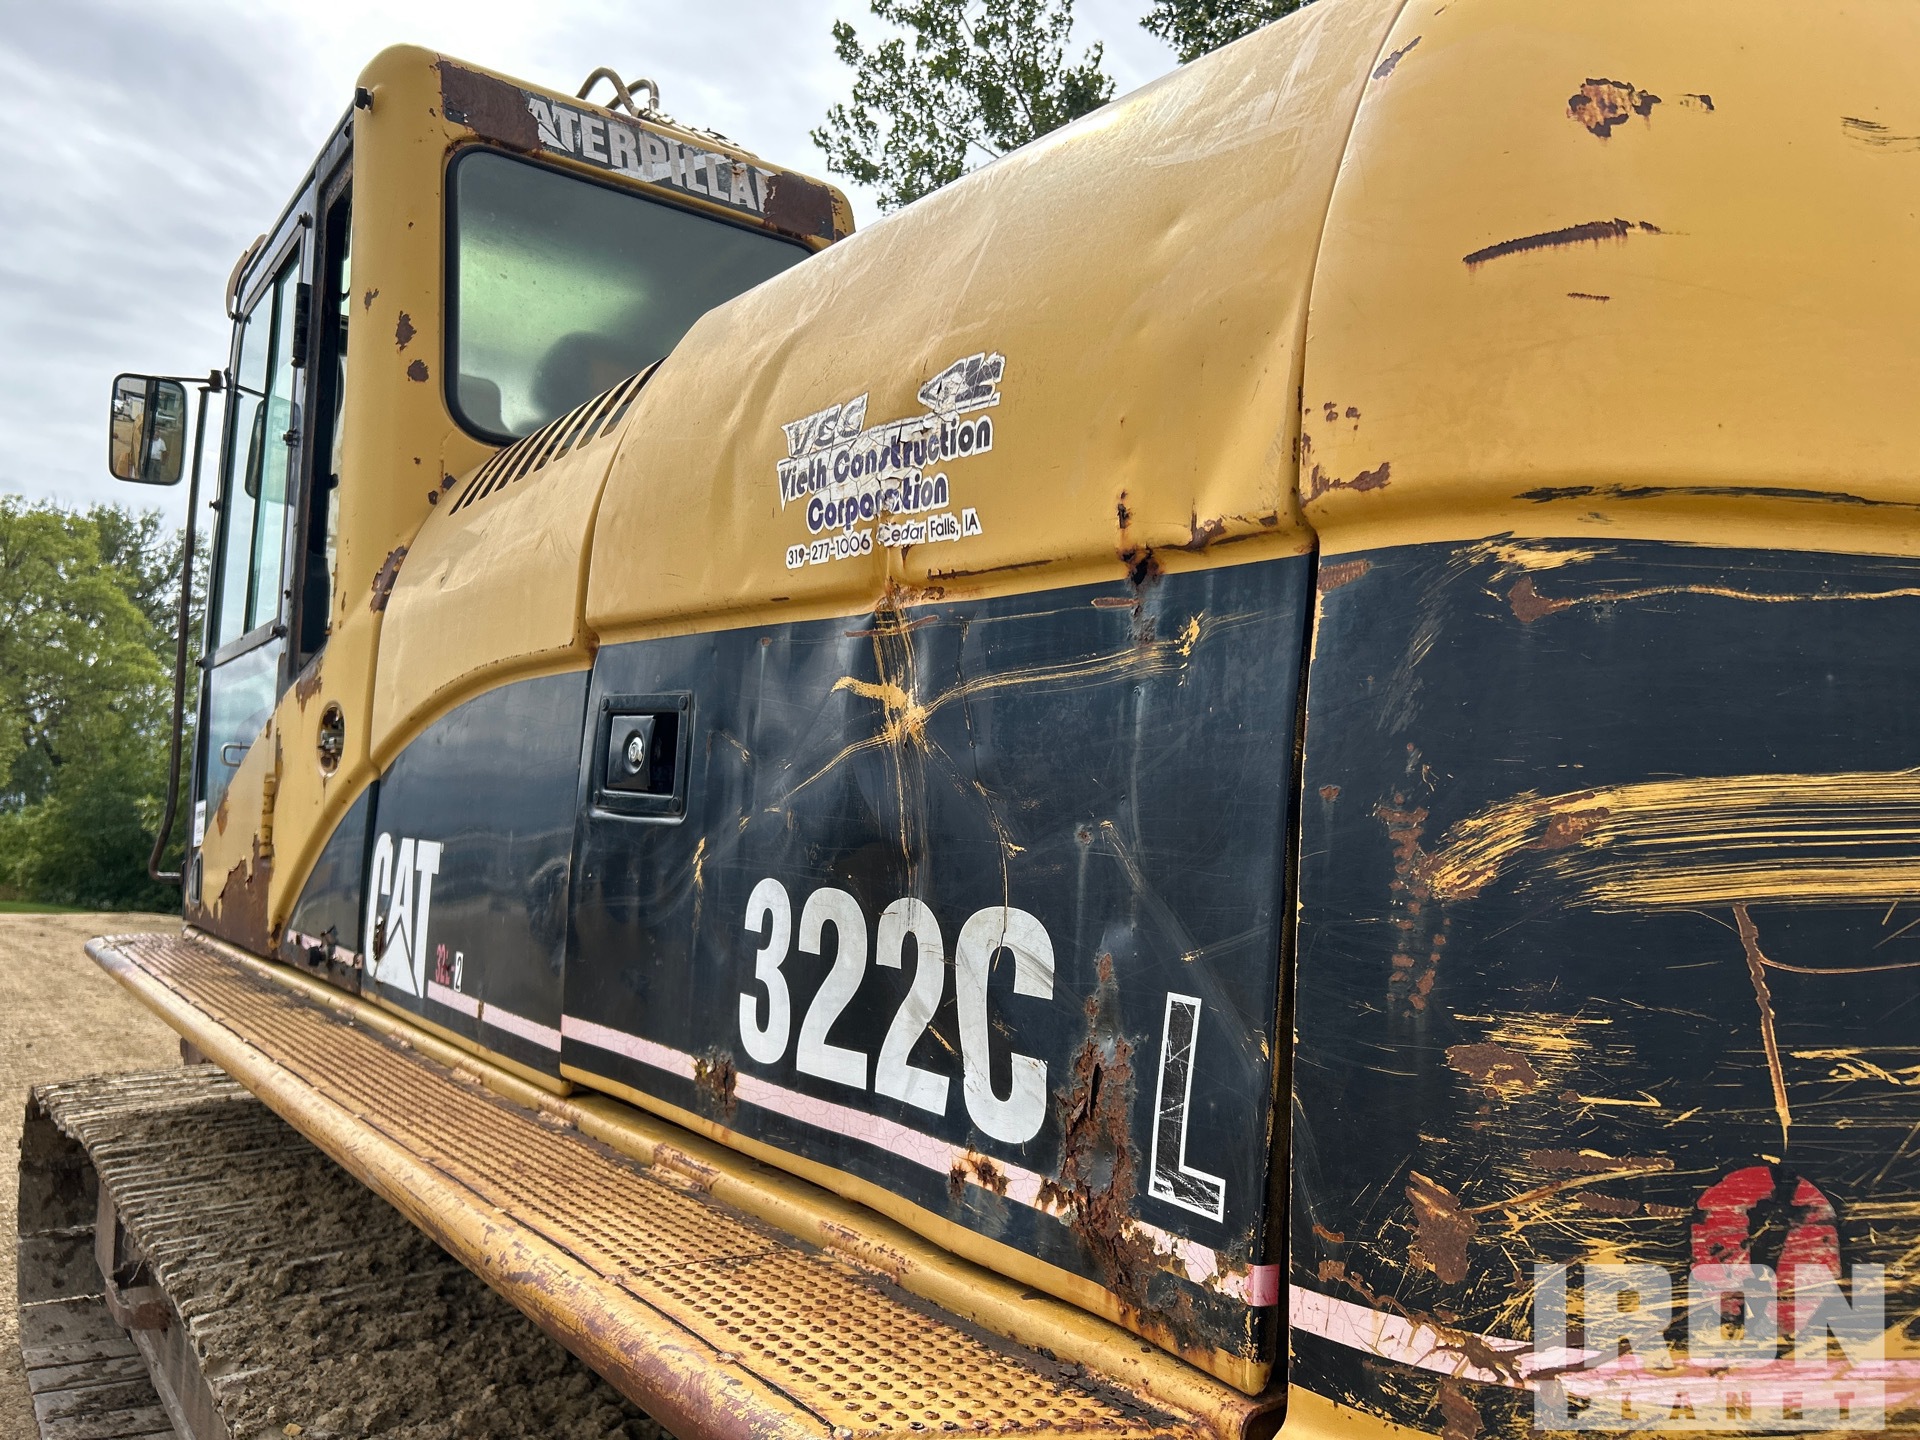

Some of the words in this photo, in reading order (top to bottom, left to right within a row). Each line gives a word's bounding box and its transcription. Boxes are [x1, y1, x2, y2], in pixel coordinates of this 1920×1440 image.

[780, 458, 827, 500] Vieth
[833, 419, 991, 484] Construction
[787, 533, 871, 566] 319-277-1006
[930, 517, 959, 538] Falls,
[965, 513, 978, 531] IA
[365, 831, 442, 999] CAT
[739, 877, 1055, 1144] 322C
[1148, 992, 1226, 1223] L
